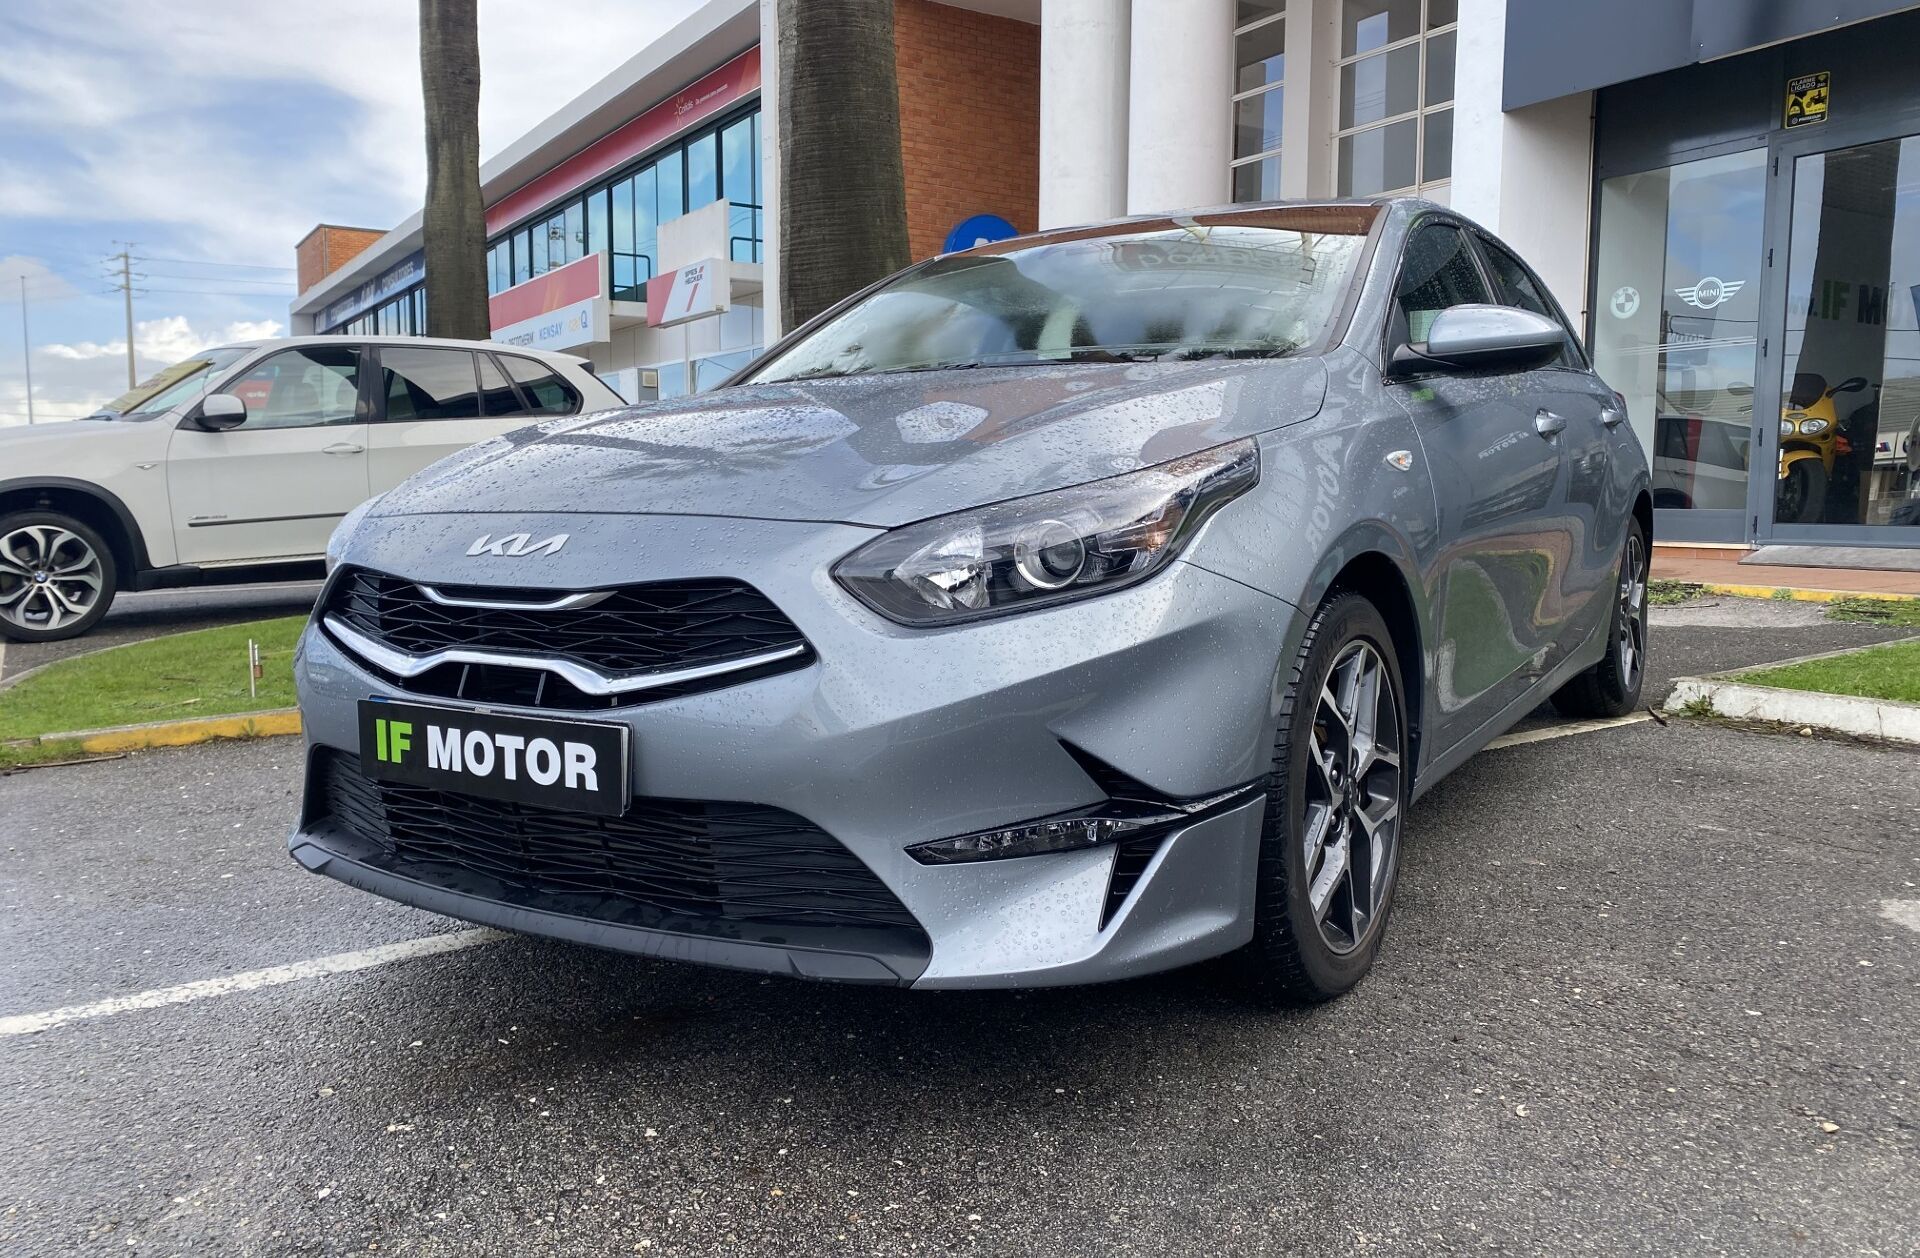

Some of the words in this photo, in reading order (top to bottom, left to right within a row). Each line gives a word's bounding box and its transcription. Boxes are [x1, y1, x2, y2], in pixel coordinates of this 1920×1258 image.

[1791, 81, 1816, 91] LIGADO
[1698, 288, 1720, 298] MINI
[375, 718, 413, 764] IF
[426, 724, 599, 792] MOTOR
